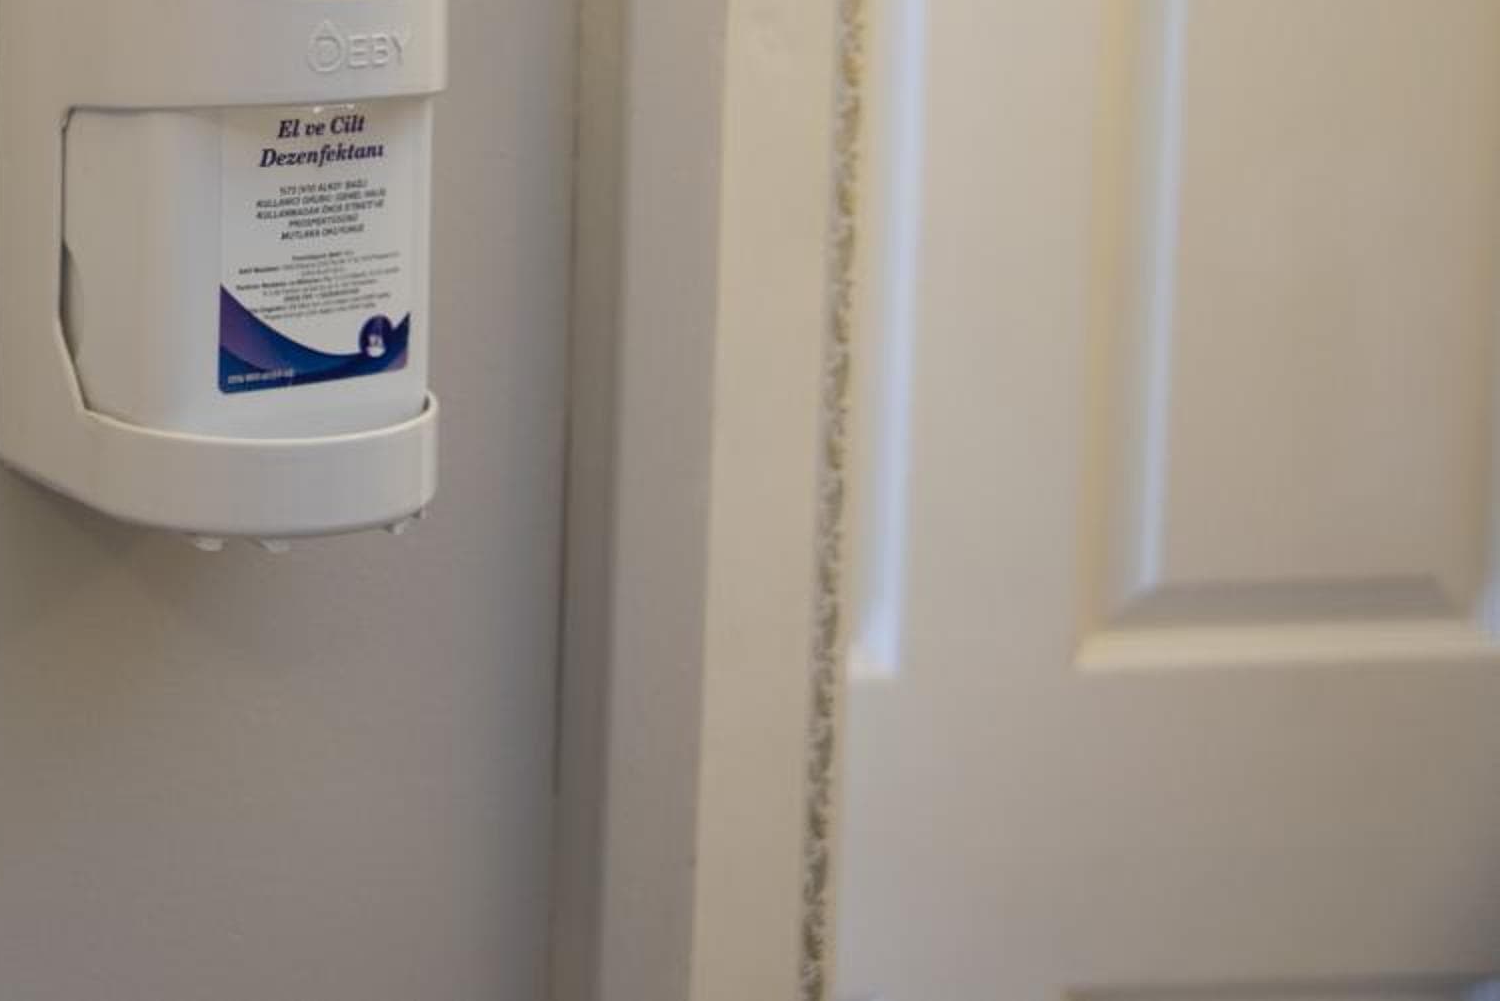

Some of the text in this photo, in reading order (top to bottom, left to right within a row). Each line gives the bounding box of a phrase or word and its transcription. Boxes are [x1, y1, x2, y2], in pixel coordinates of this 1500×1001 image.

[277, 113, 366, 139] El ve Cilt
[260, 142, 384, 168] Dezenfektanı
